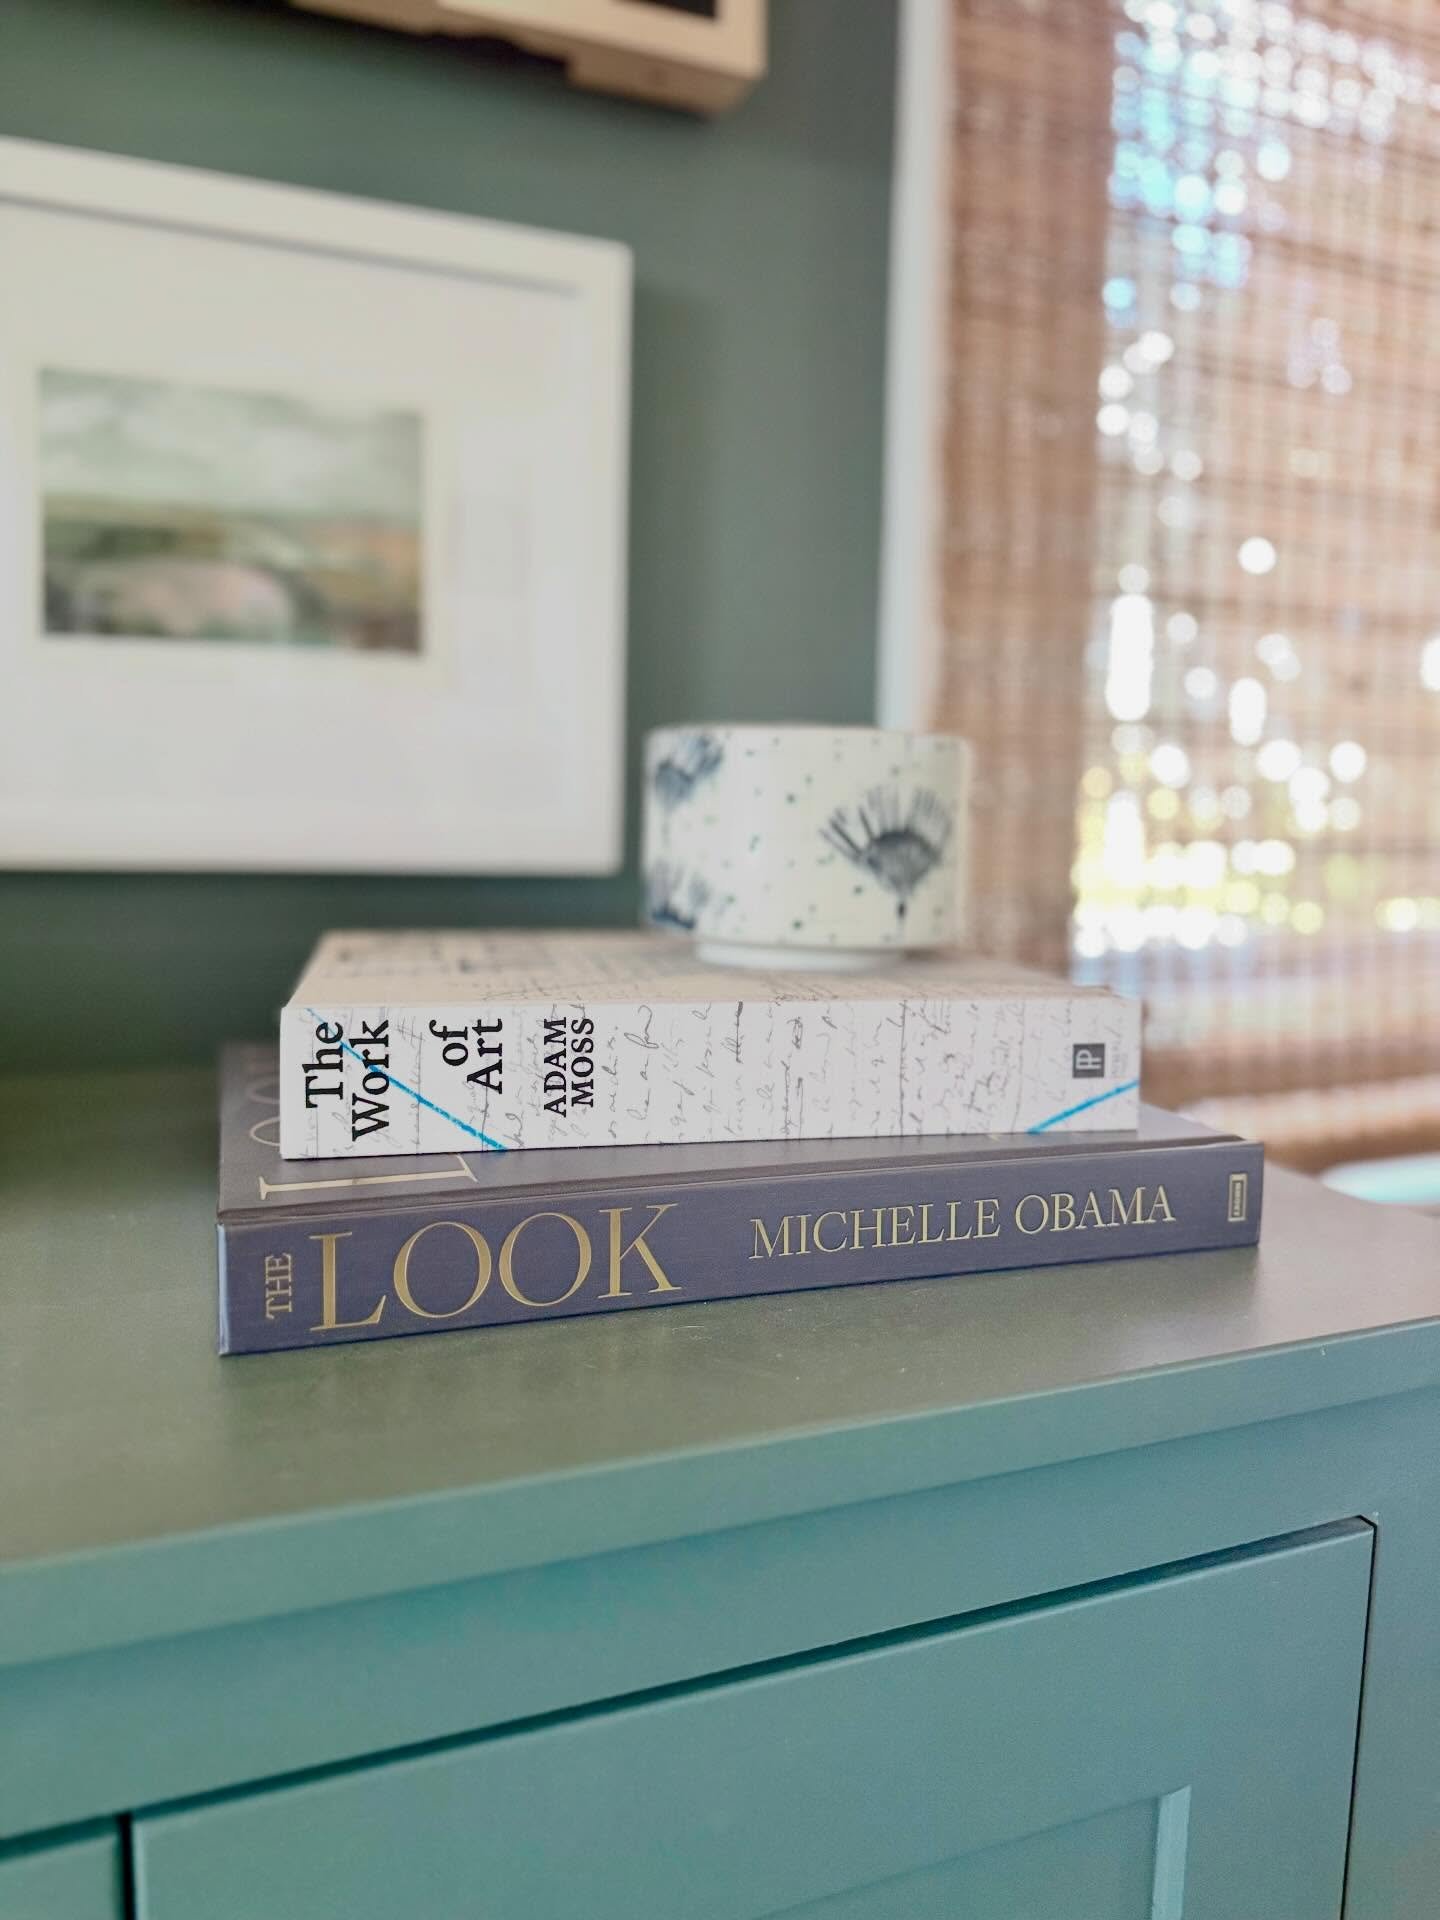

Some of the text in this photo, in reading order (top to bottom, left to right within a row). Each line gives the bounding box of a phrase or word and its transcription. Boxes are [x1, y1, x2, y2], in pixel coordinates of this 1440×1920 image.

[303, 1021, 344, 1109] The
[352, 1018, 390, 1142] Work
[428, 1019, 468, 1066] of
[467, 1018, 504, 1095] Art
[543, 1016, 567, 1118] ADAM
[570, 1017, 595, 1108] MOSS
[749, 1198, 1000, 1259] MICHELLE
[1014, 1184, 1177, 1236] OBAMA
[264, 1252, 292, 1320] THE
[308, 1202, 682, 1332] LOOK
